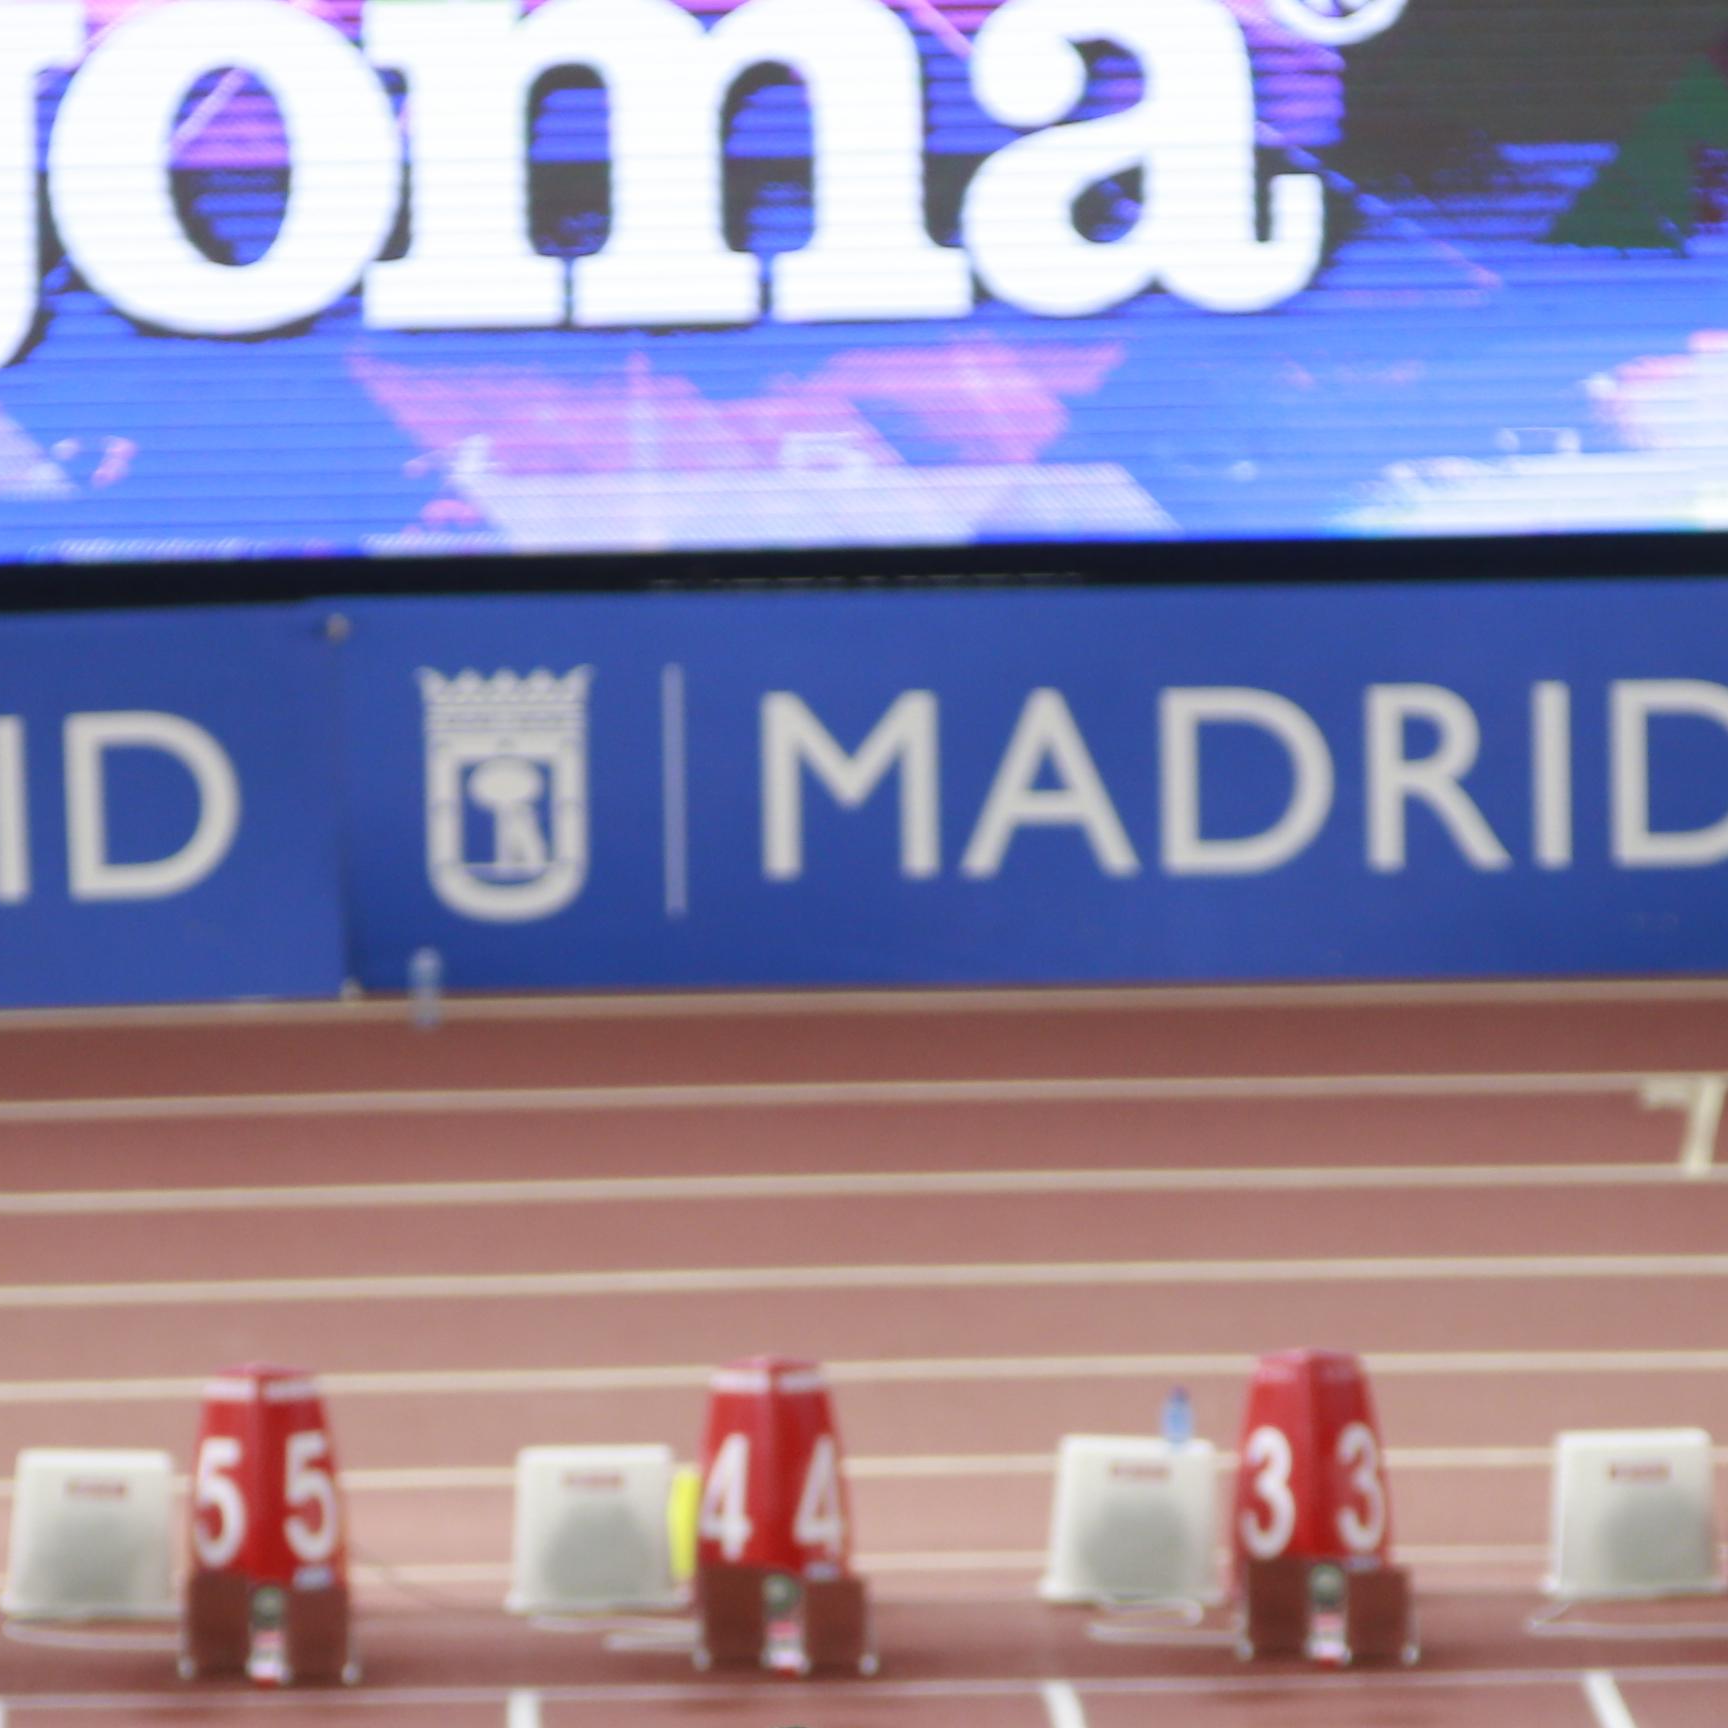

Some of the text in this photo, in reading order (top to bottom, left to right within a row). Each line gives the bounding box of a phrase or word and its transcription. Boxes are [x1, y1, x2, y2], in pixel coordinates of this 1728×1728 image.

[194, 1435, 247, 1568] 5
[284, 1429, 338, 1562] 5
[699, 1432, 754, 1563] 4
[793, 1431, 843, 1558] 4
[1241, 1424, 1296, 1560] 3
[1336, 1421, 1386, 1552] 3
